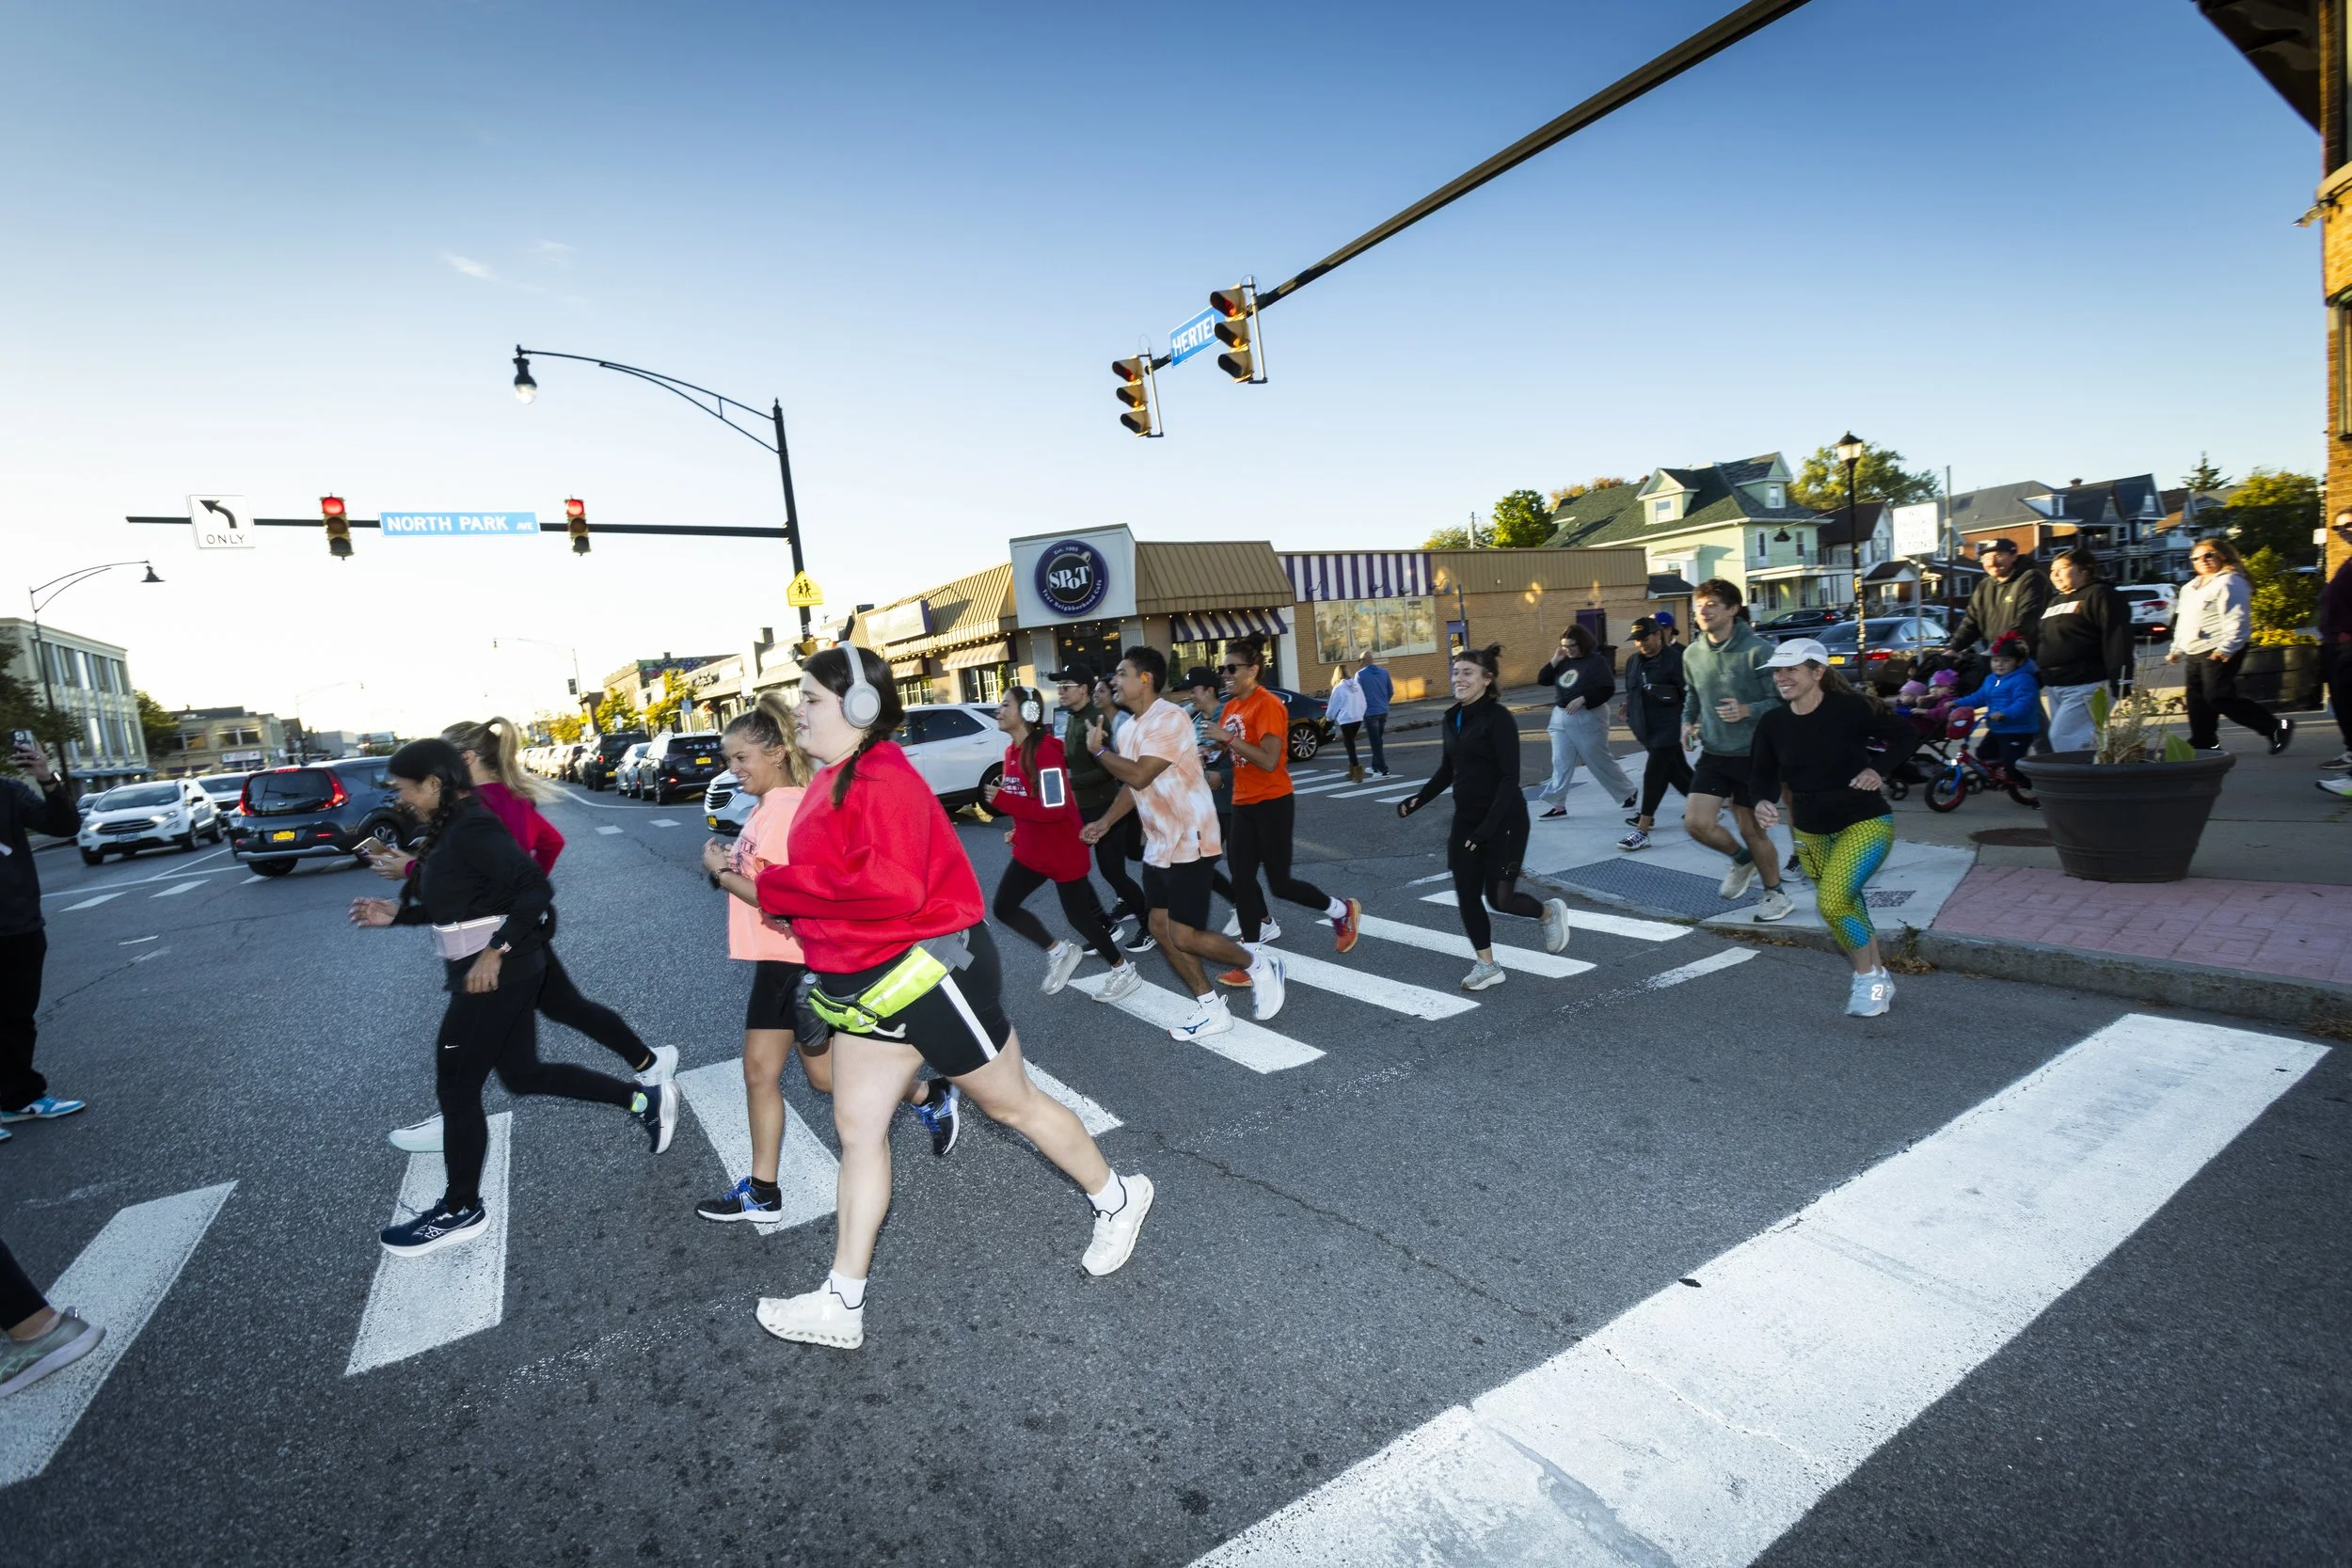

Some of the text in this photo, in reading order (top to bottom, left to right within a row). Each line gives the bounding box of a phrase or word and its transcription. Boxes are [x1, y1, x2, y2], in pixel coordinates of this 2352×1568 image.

[386, 515, 534, 531] NORTH PARK AVE
[206, 533, 246, 545] ONLY
[1907, 539, 1934, 550] TONS
[1053, 594, 1096, 611] Neighborhood
